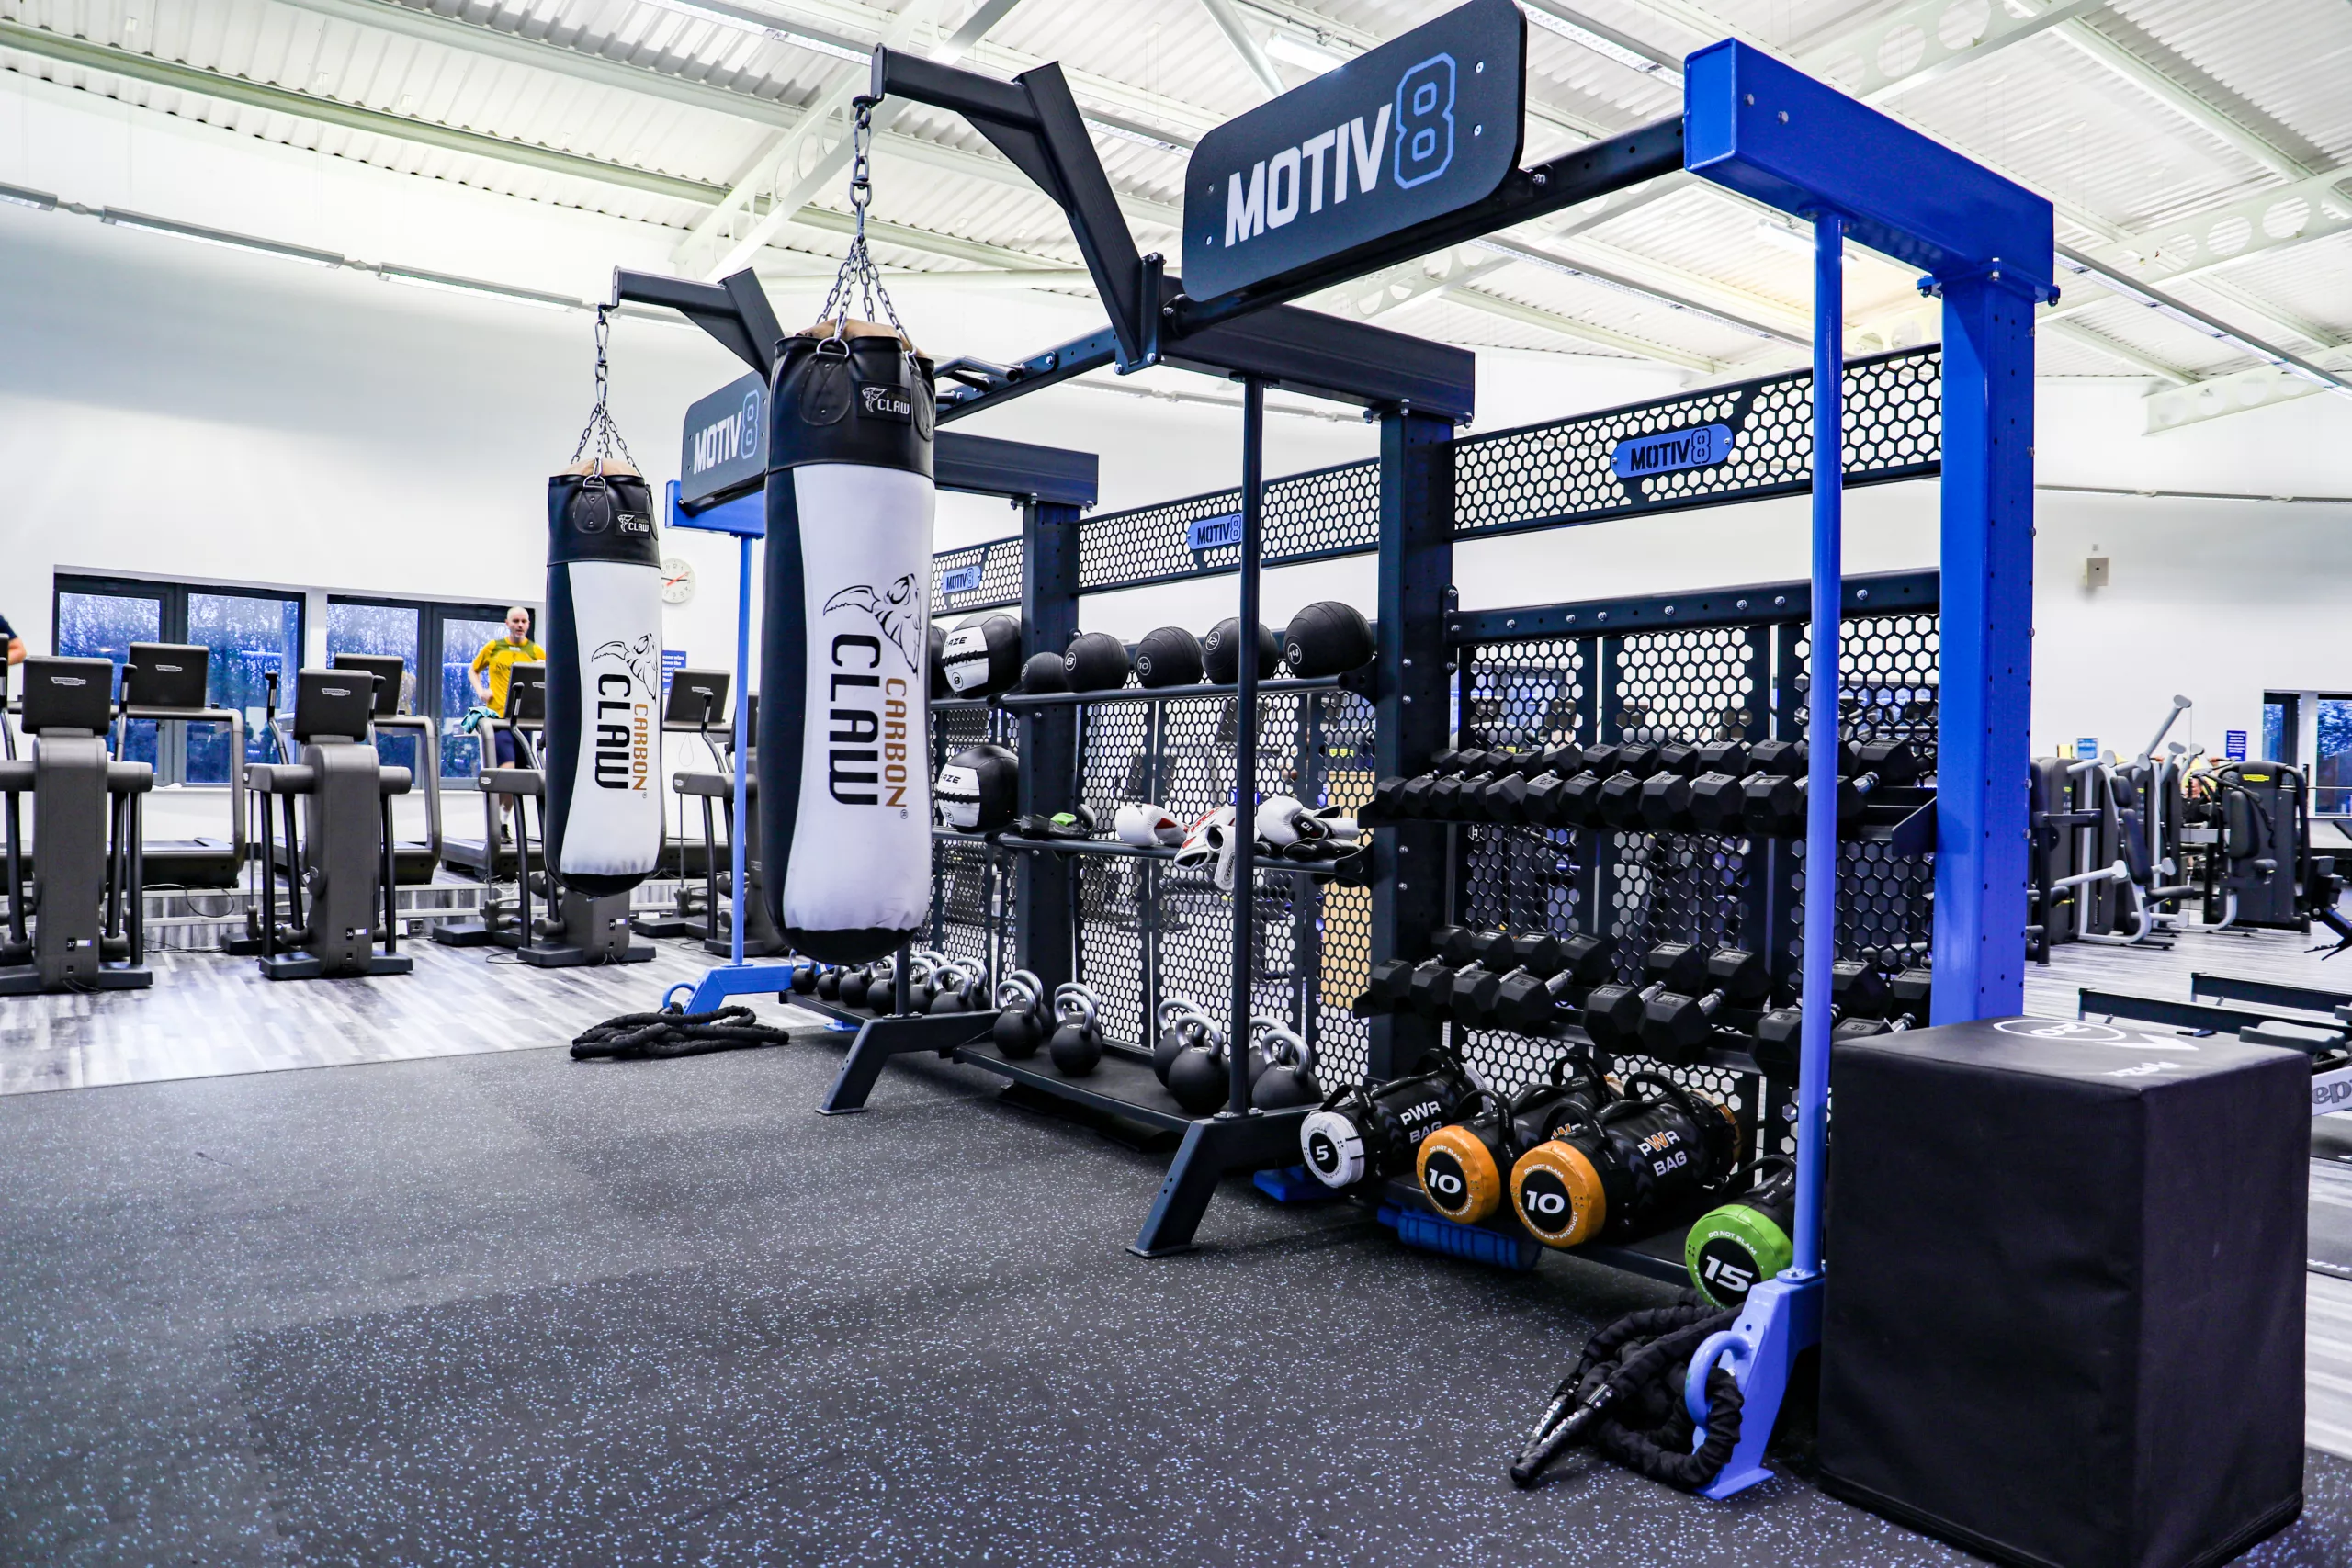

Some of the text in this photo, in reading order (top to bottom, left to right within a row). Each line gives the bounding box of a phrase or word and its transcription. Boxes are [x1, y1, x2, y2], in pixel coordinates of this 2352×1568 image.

[1225, 52, 1455, 249] MOTIV8
[877, 399, 910, 415] CLAW
[694, 389, 759, 475] MOTIV8
[1630, 428, 1711, 471] MOTIV8
[628, 522, 649, 533] CLAW
[1197, 514, 1241, 545] MOTIV8
[946, 567, 974, 591] MOTIV8
[1207, 636, 1217, 646] 12
[1066, 657, 1075, 666] 8
[1289, 649, 1299, 660] 14
[595, 673, 631, 789] CLAW
[829, 634, 881, 805] CLAW
[1399, 1100, 1442, 1126] PWR
[1316, 1145, 1329, 1162] 5
[1448, 1148, 1463, 1163] SLAM
[1637, 1130, 1680, 1156] PWR
[1524, 1166, 1532, 1175] DO
[1546, 1165, 1564, 1179] SLAM
[1653, 1150, 1688, 1177] BAG
[1429, 1168, 1462, 1194] 10
[1456, 1193, 1474, 1216] PRODUCT
[1526, 1190, 1565, 1213] 10
[1559, 1211, 1578, 1239] PRODUCT
[1708, 1230, 1758, 1256] DO NOT SLAM
[1704, 1255, 1754, 1292] 15
